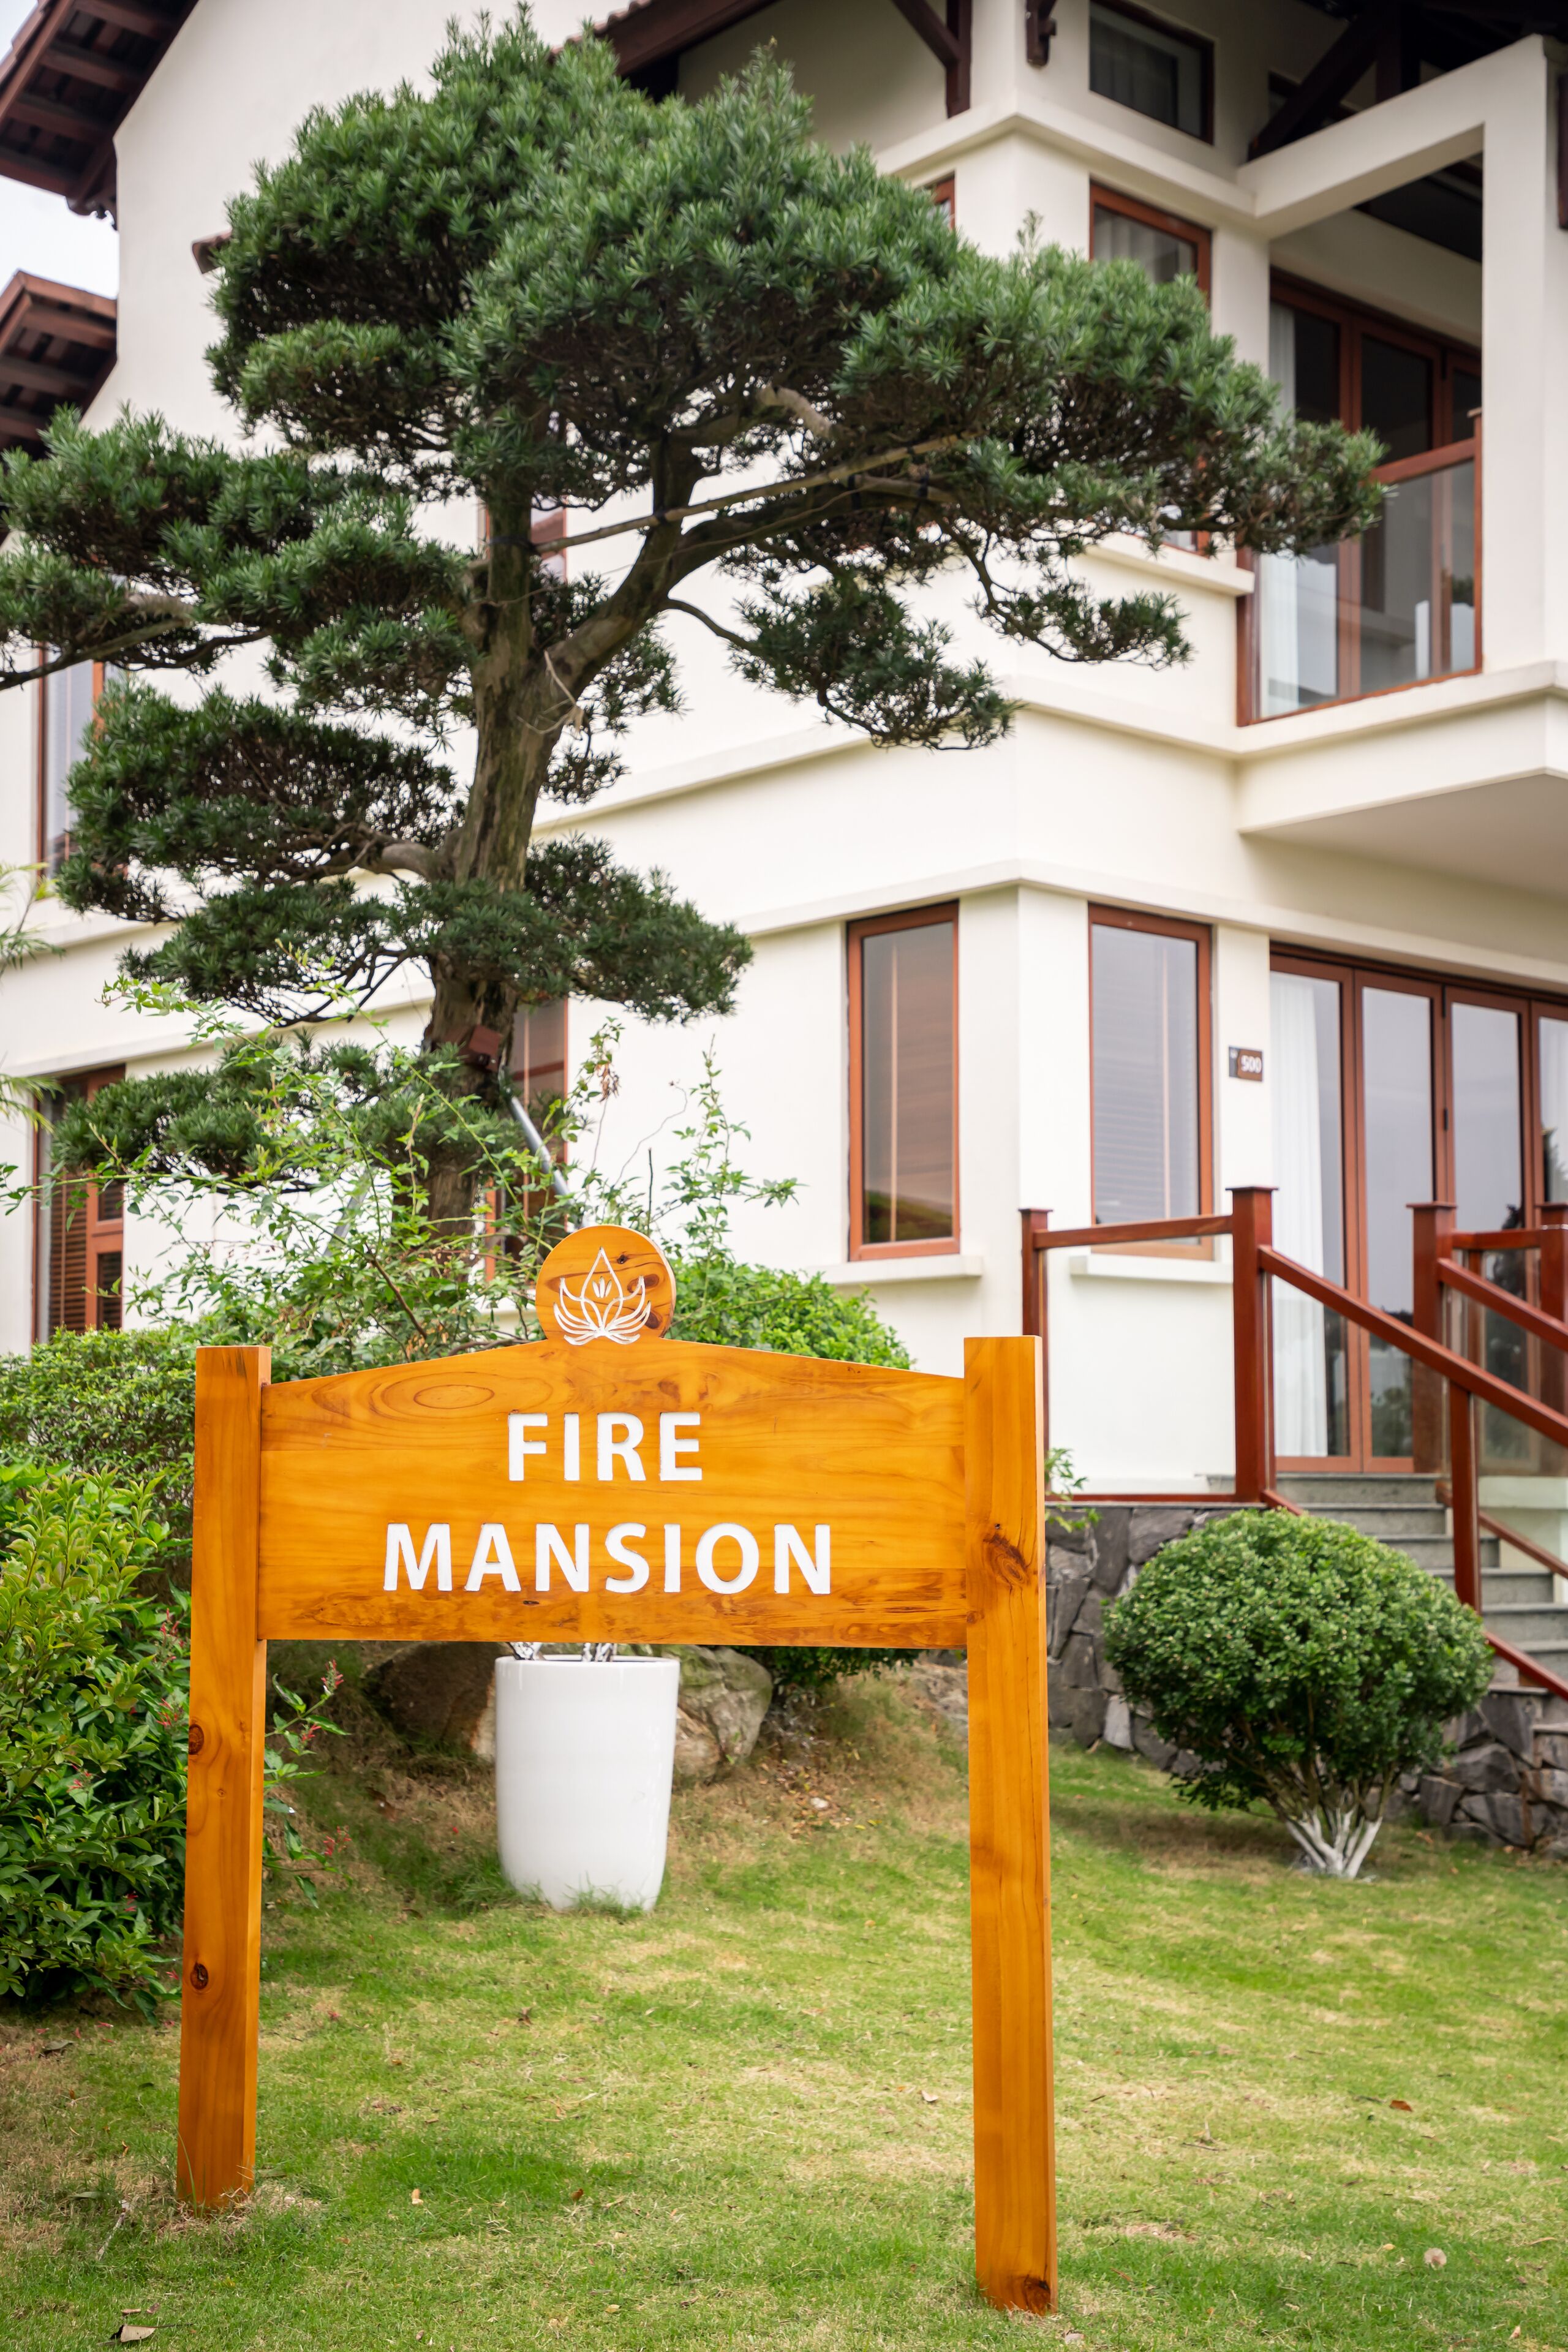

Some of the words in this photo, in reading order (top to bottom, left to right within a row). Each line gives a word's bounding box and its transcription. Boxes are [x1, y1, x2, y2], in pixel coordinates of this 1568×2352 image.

[1241, 1055, 1262, 1073] 500
[508, 1412, 703, 1482] FIRE
[383, 1522, 831, 1594] MANSION
